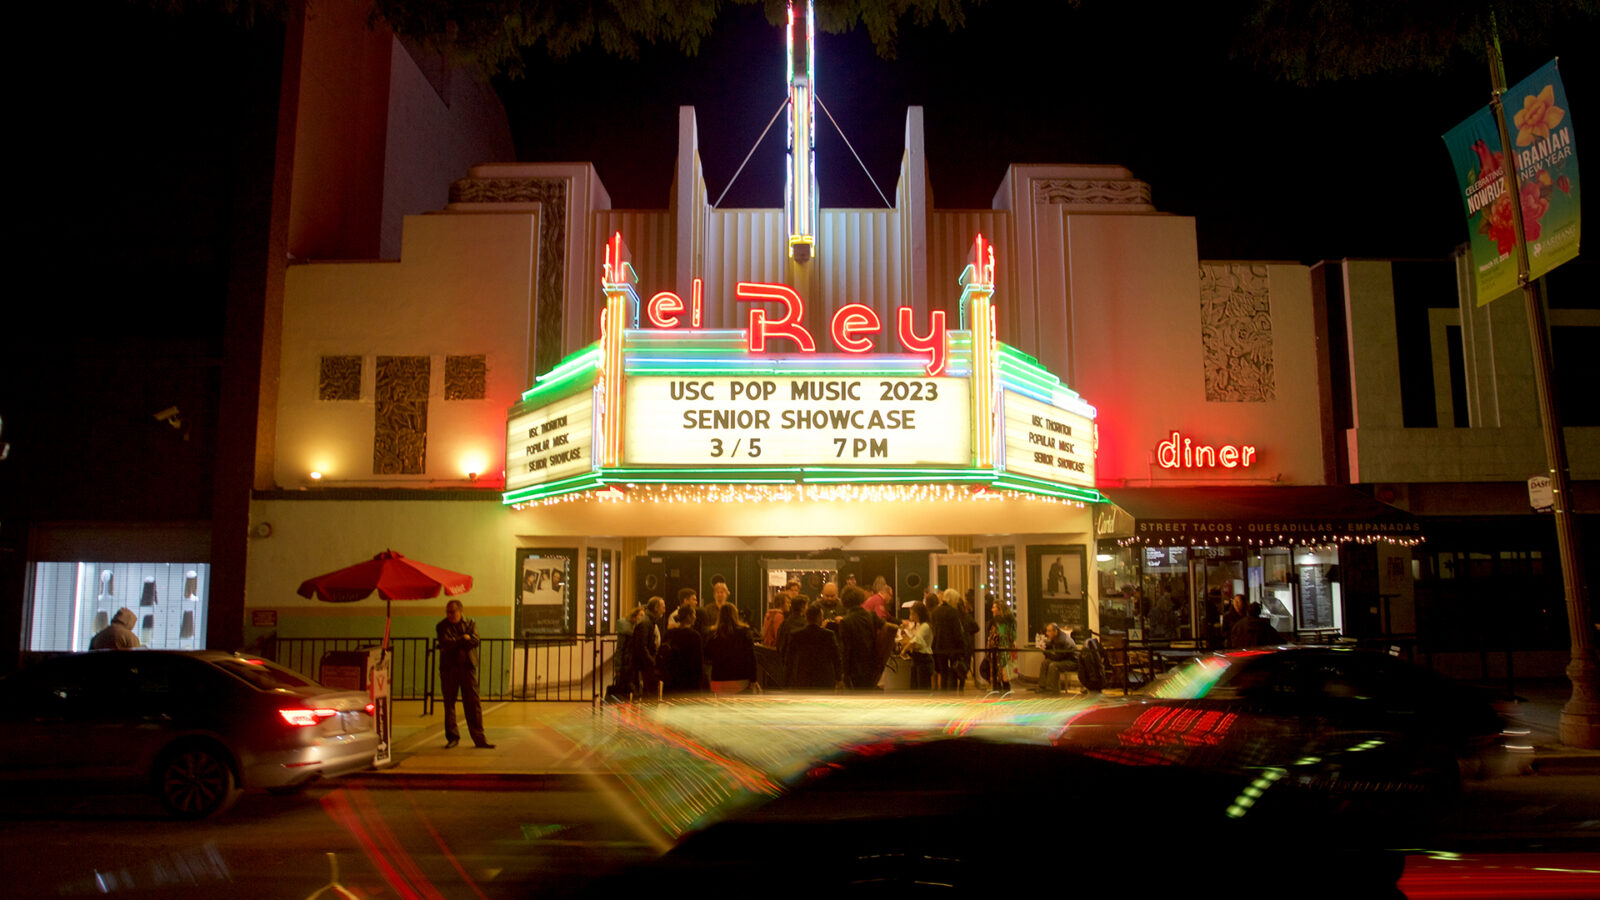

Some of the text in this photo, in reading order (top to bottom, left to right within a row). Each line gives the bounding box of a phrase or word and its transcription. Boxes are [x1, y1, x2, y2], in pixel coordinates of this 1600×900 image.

[1518, 127, 1571, 171] IRANIAN
[1520, 146, 1572, 181] NEW YEAR
[1465, 167, 1504, 197] CELEBRATING
[1466, 177, 1507, 215] NOWRUZ
[647, 278, 946, 377] el Rey
[669, 381, 939, 401] USC POP MUSIC 2023
[682, 409, 916, 430] SENIOR SHOWCASE
[1031, 414, 1043, 428] USC
[526, 439, 550, 456] POPULAR
[833, 438, 888, 458] 7PM
[1028, 431, 1075, 454] POPULAR MUSIC
[1157, 431, 1256, 469] diner
[528, 447, 581, 472] SENIOR SHOWCASE
[1034, 451, 1085, 473] SENIOR SHOWCASE
[1140, 522, 1420, 532] STREET TACOS QUESADILLAS EMPANADAS
